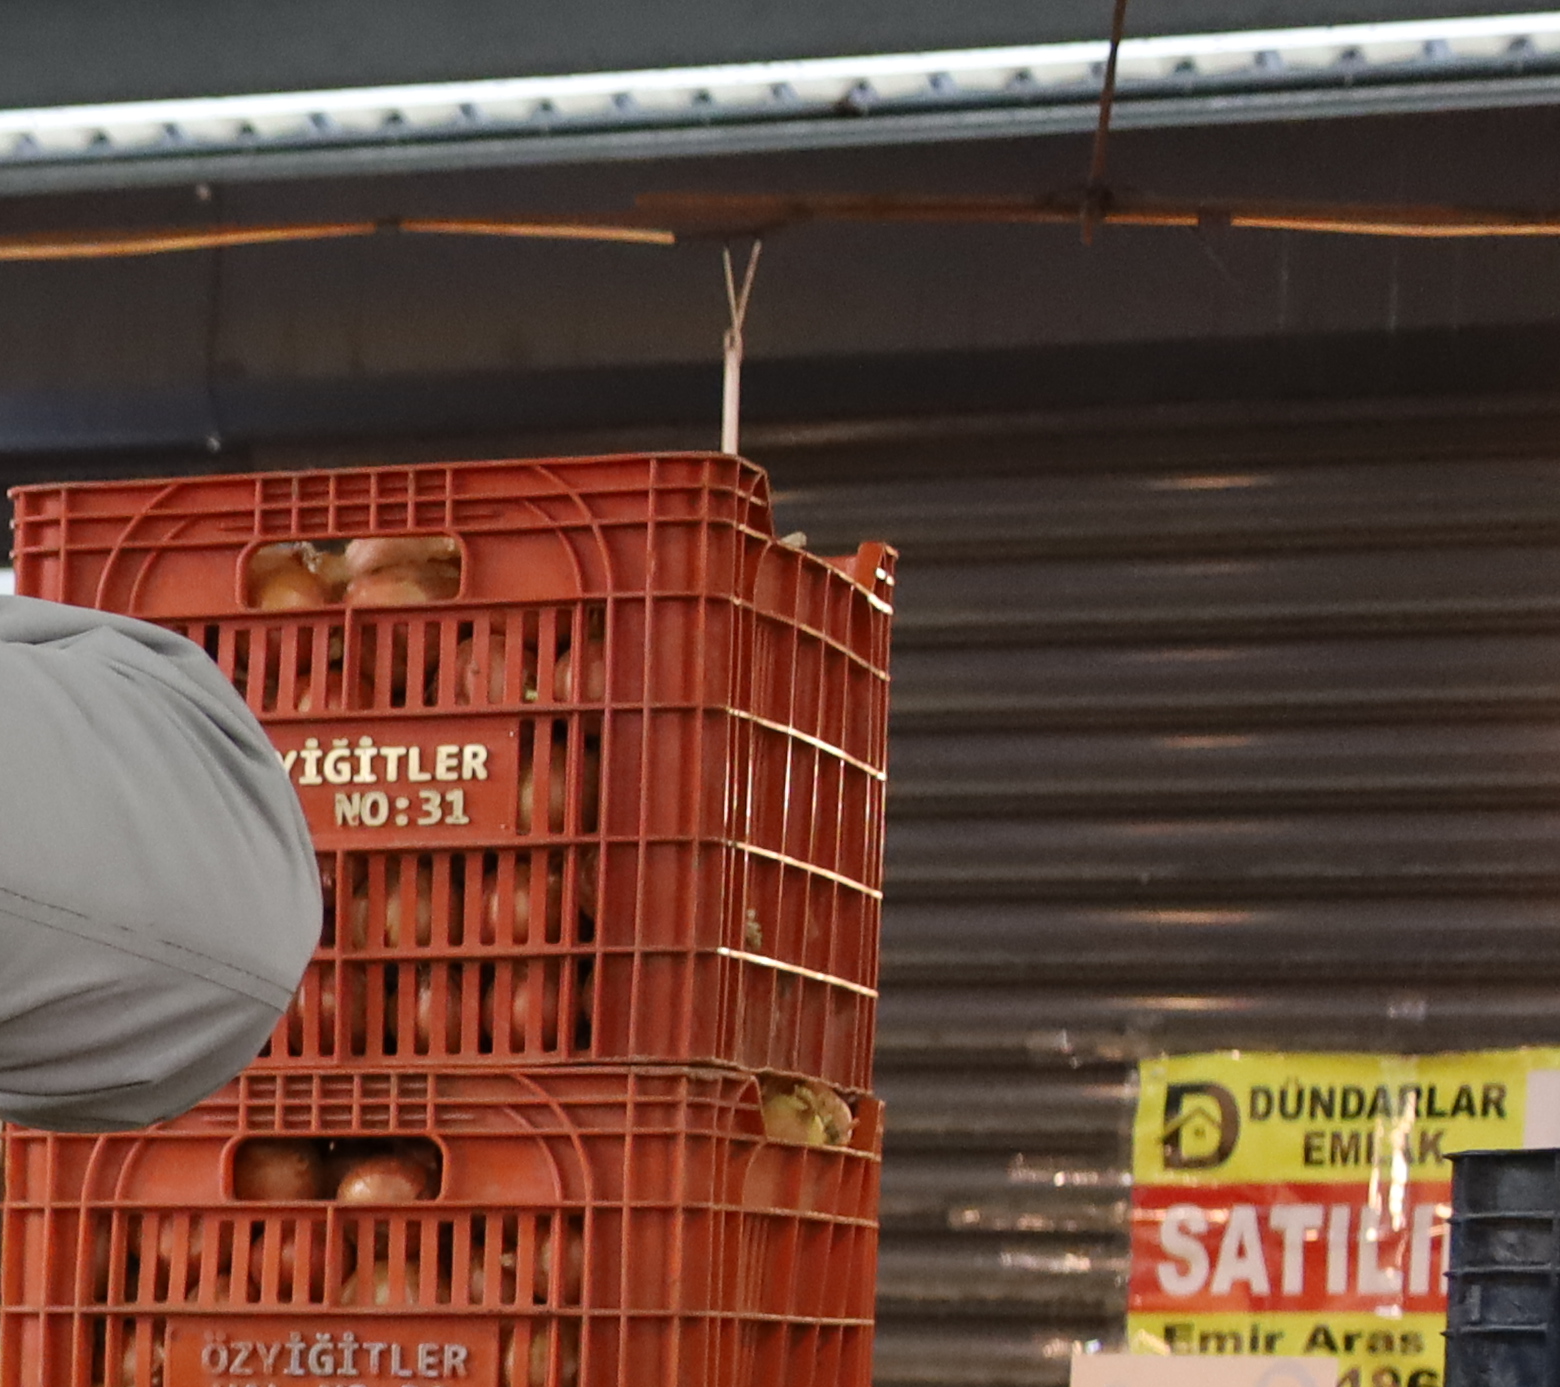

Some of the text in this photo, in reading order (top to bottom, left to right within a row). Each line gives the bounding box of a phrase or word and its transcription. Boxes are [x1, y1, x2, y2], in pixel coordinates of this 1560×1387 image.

[277, 735, 489, 785] YİĞİTLER
[334, 788, 469, 827] NO:31
[1248, 1074, 1507, 1121] DÜNDARLAR
[1156, 1202, 1449, 1297] SATILI
[200, 1330, 469, 1378] ÖZYİĞİTLER
[1303, 1323, 1425, 1355] Aras
